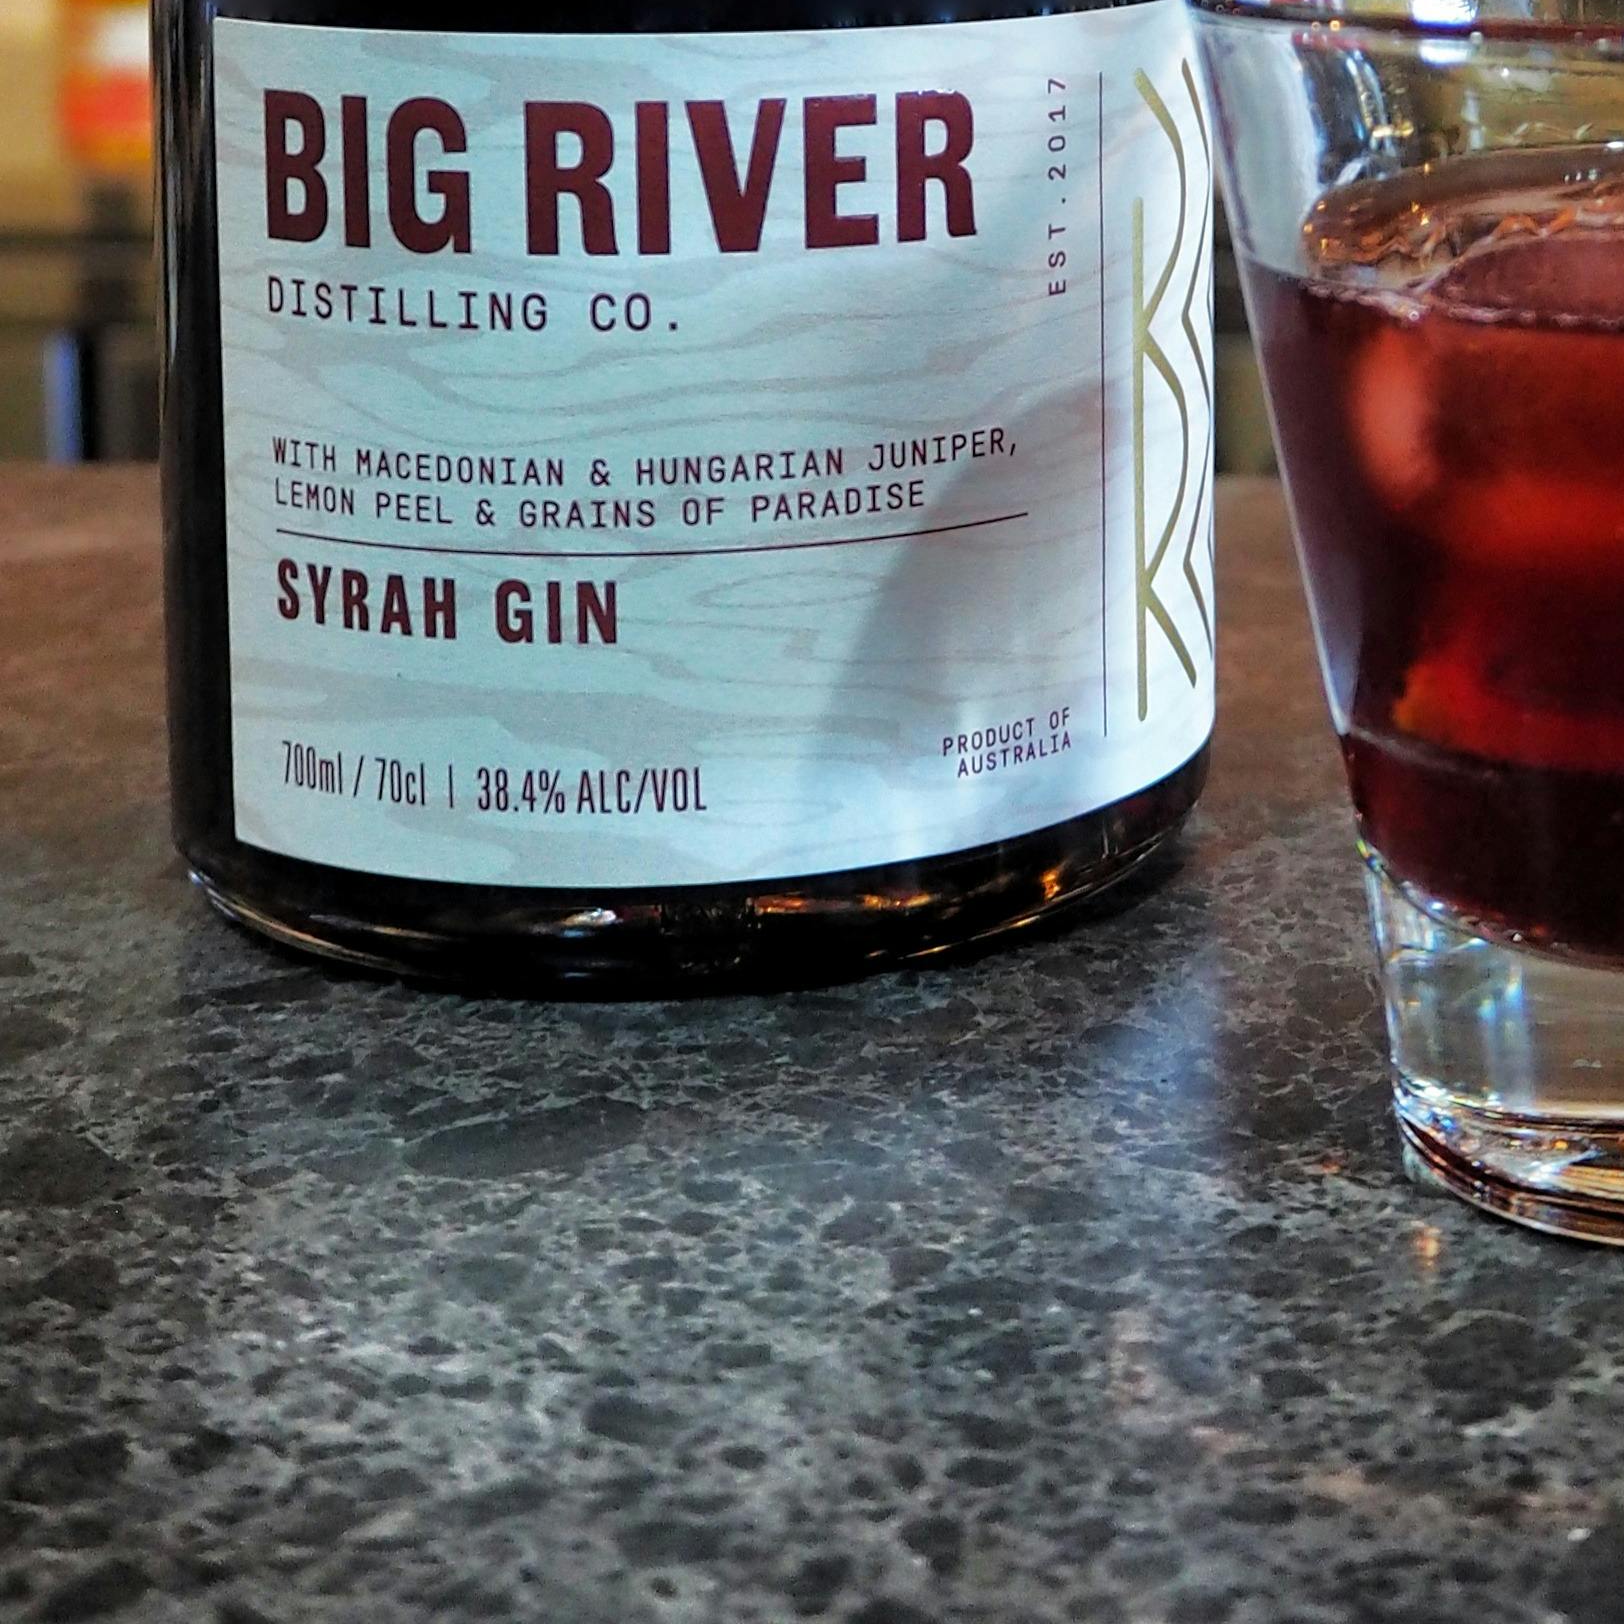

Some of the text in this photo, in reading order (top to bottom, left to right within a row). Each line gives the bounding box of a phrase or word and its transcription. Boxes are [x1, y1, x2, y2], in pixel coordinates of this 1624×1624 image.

[263, 88, 978, 257] BIG RIVER
[267, 276, 679, 332] DISTILLING CO.
[272, 427, 1017, 487] WITH MACEDONIAN & HUNGARIAN JUNIPER,
[274, 477, 926, 528] LEMON PEEL & GRAINS OF PARADISE
[276, 557, 618, 644] SYRAH GIN
[943, 706, 1070, 757] PRODUCT OF
[957, 730, 1071, 778] AUSTRALIA
[282, 740, 343, 795] 700ml
[375, 757, 426, 806] 70cl
[477, 767, 566, 814] 38.4%
[576, 765, 708, 814] ALC/VOL
